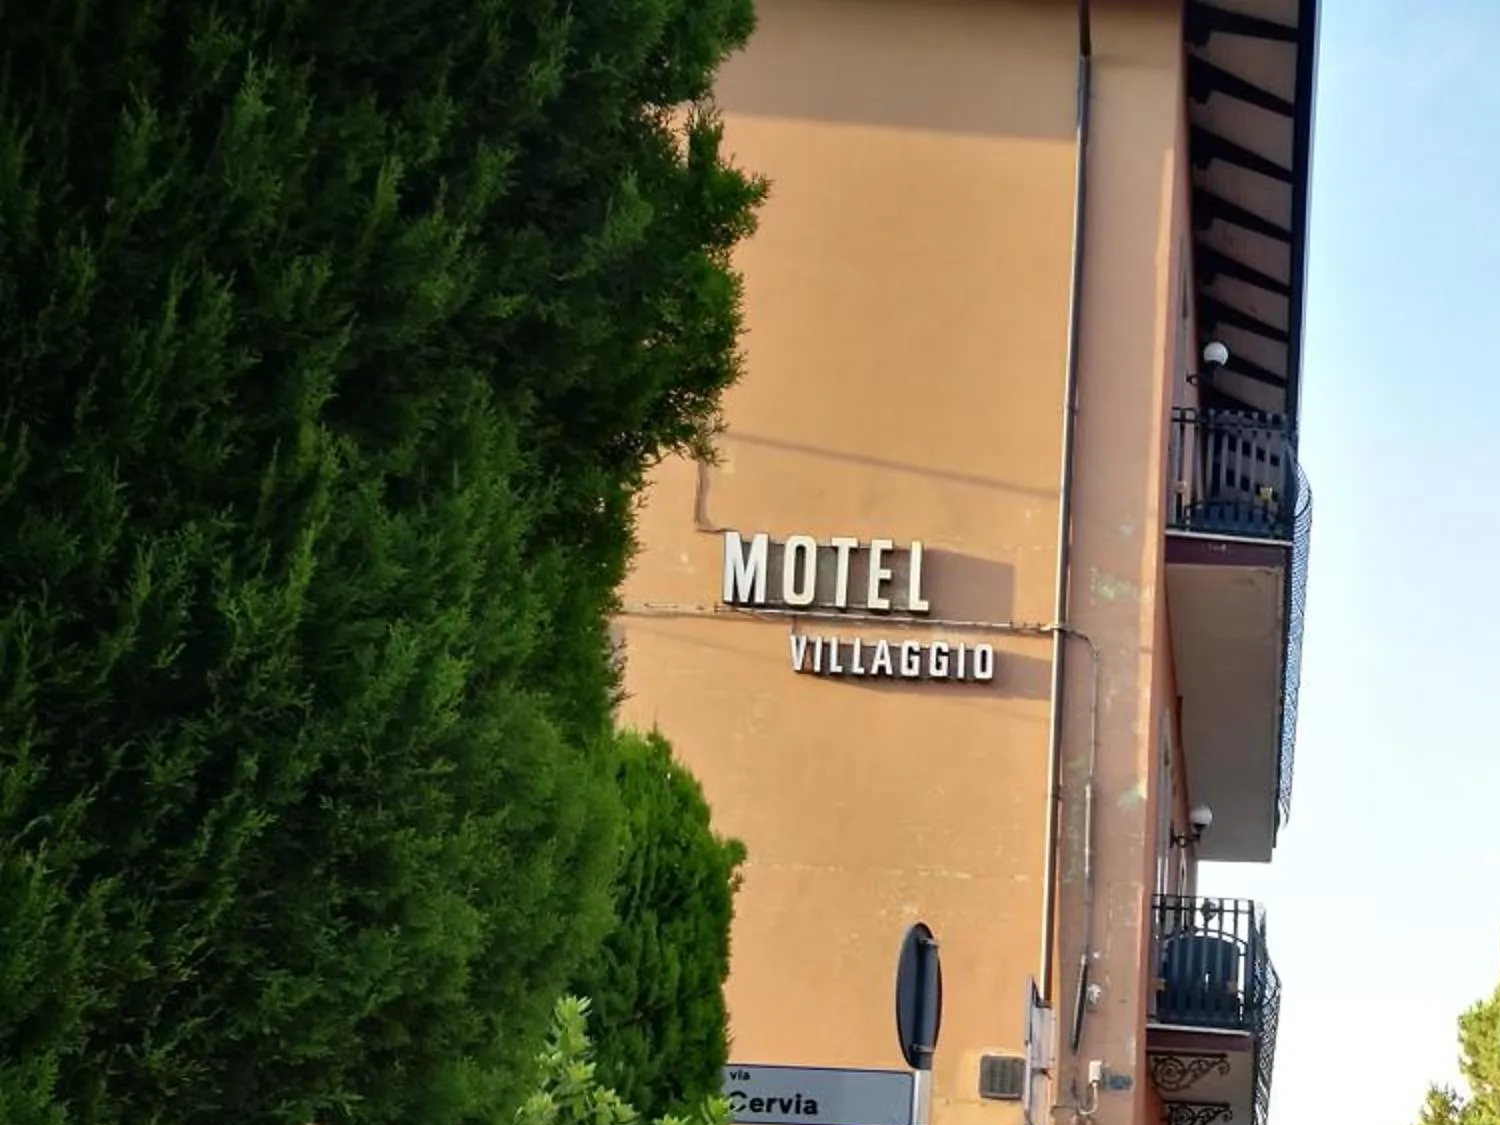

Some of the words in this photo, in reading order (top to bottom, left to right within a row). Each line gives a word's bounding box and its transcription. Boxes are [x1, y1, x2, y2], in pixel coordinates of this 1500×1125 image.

[723, 531, 930, 612] MOTEL
[790, 635, 994, 680] VILLAGGIO
[729, 1070, 751, 1081] via
[729, 1090, 819, 1115] Cervia
